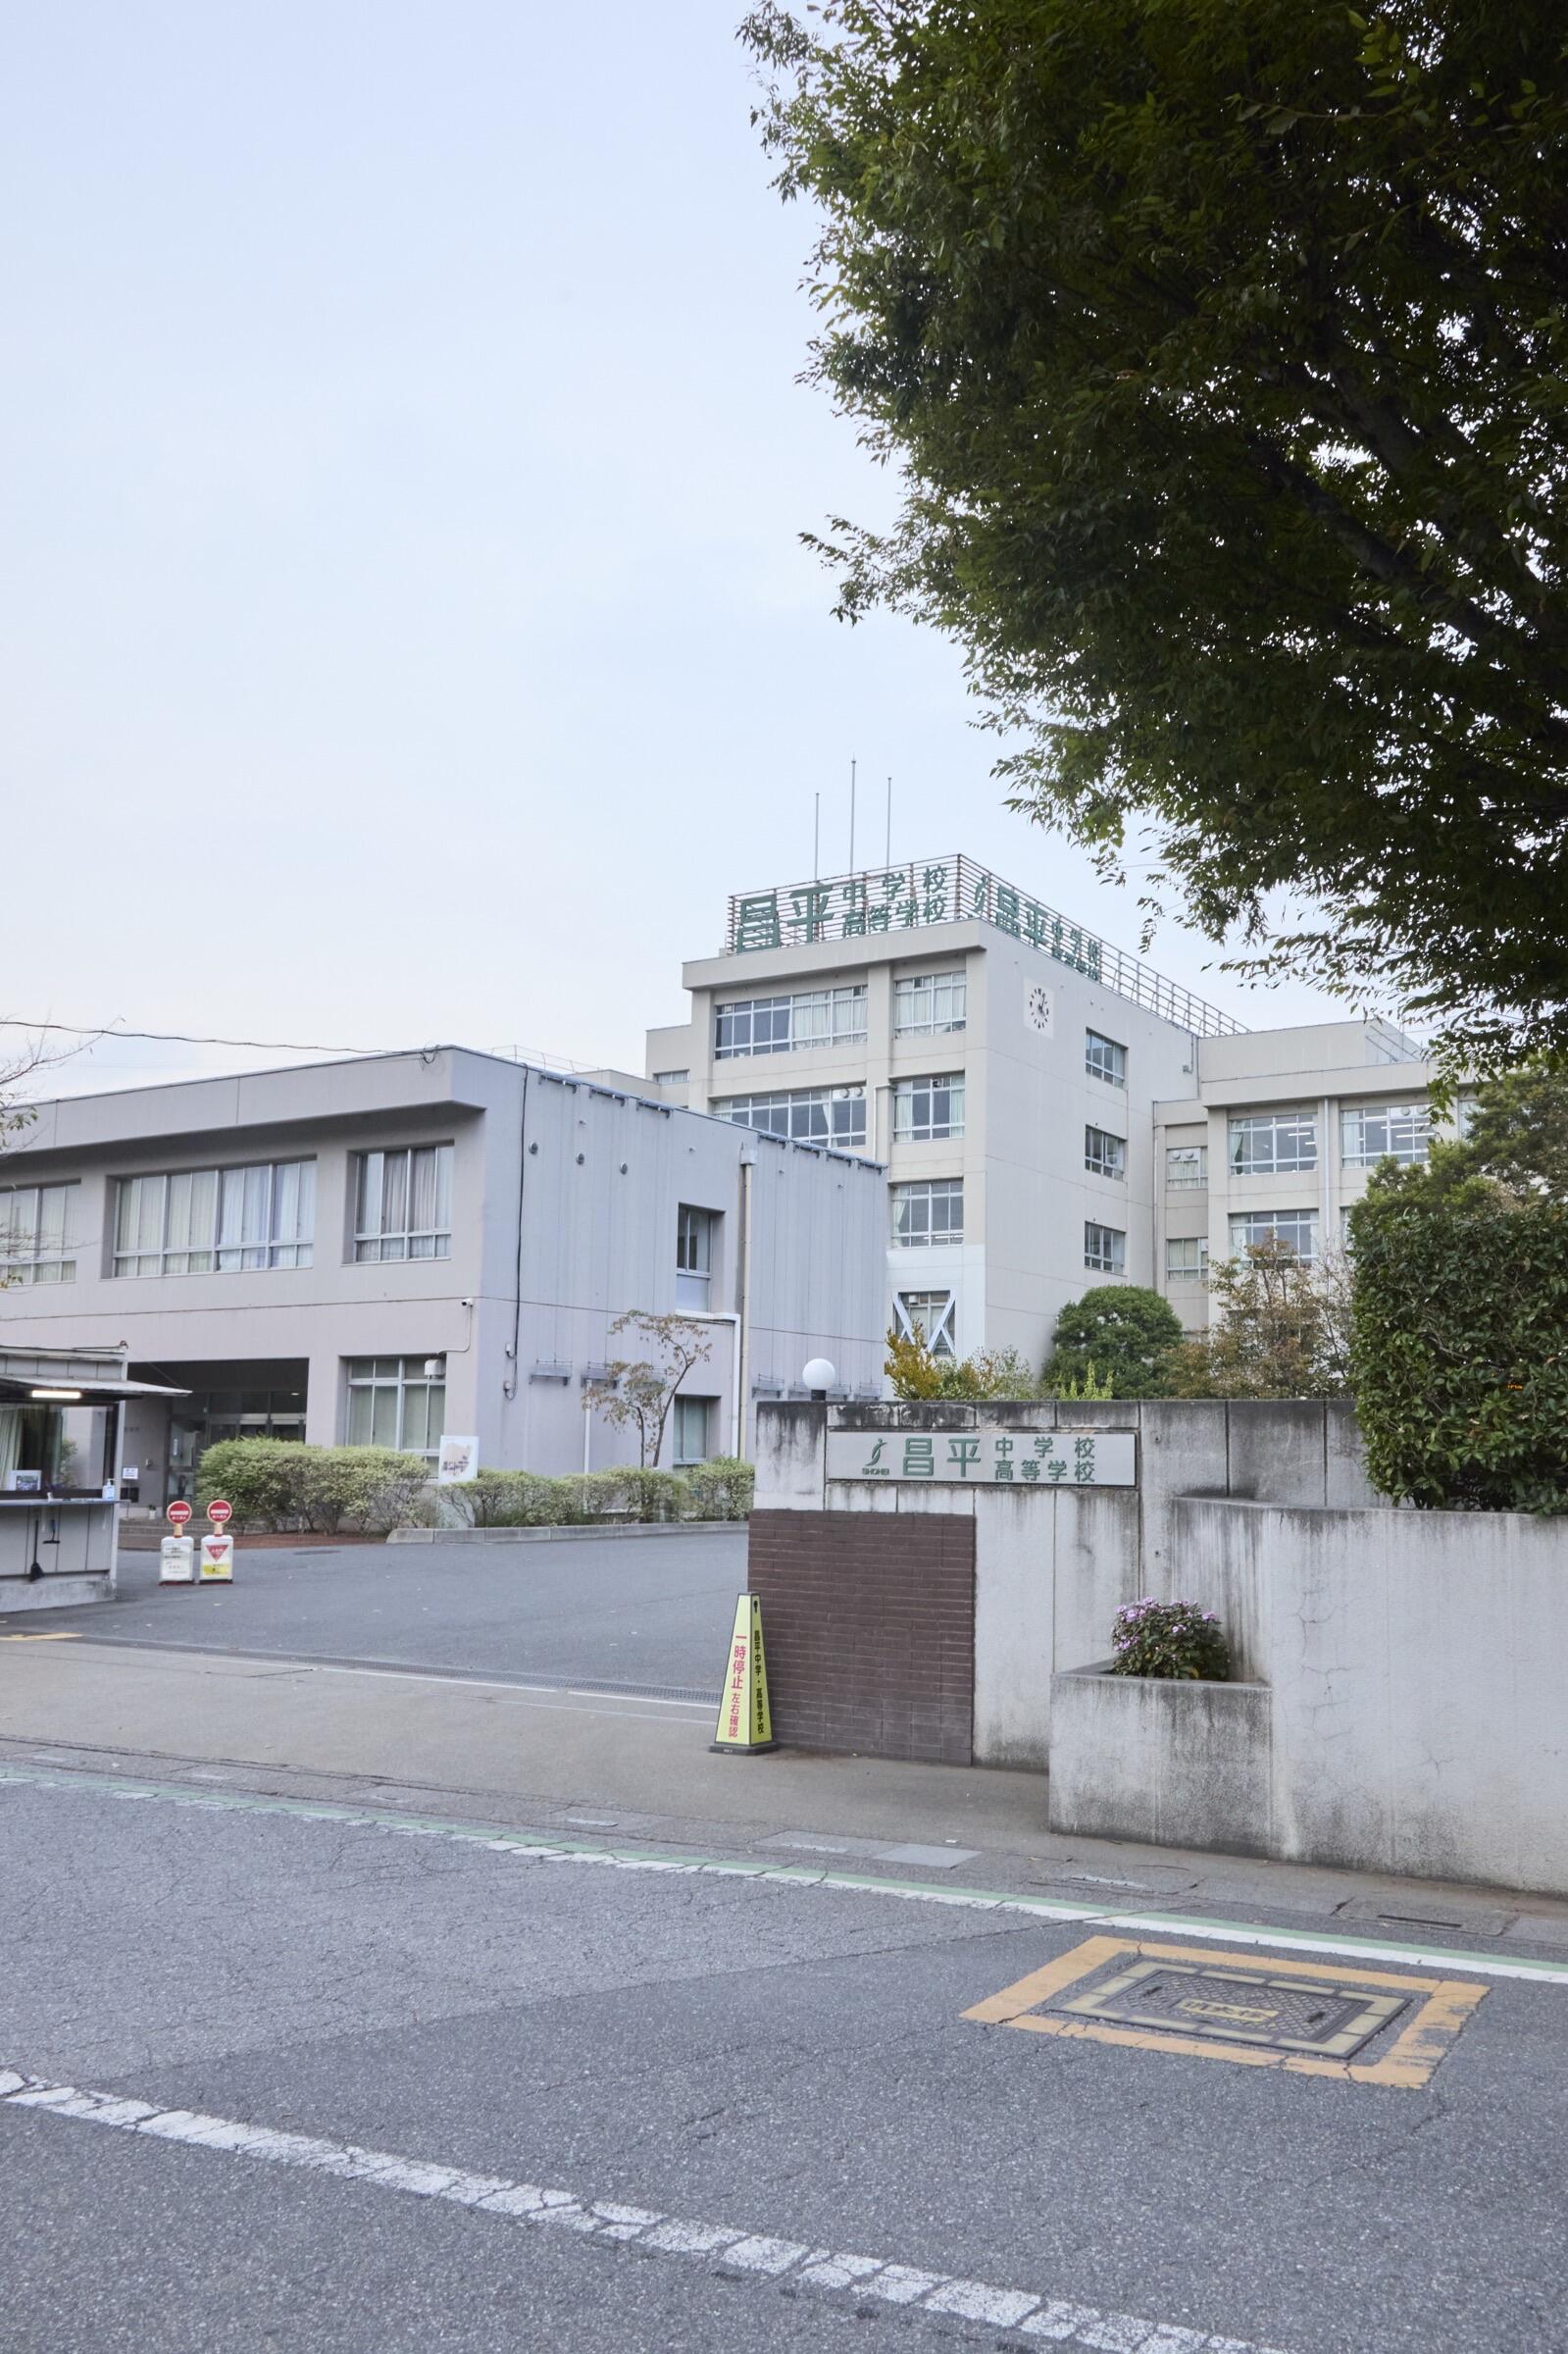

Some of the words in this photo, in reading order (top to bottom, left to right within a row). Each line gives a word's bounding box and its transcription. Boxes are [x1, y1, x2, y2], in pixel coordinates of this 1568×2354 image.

[841, 865, 949, 905] 中学校
[736, 883, 835, 953] 昌平
[841, 895, 949, 938] 高等学校
[995, 885, 1049, 948] 昌平
[902, 1437, 982, 1477] 昌平
[994, 1436, 1096, 1458] 中学校
[994, 1458, 1096, 1482] 高等学校
[731, 1635, 747, 1689] 一時停止
[729, 1693, 741, 1738] 左右確認
